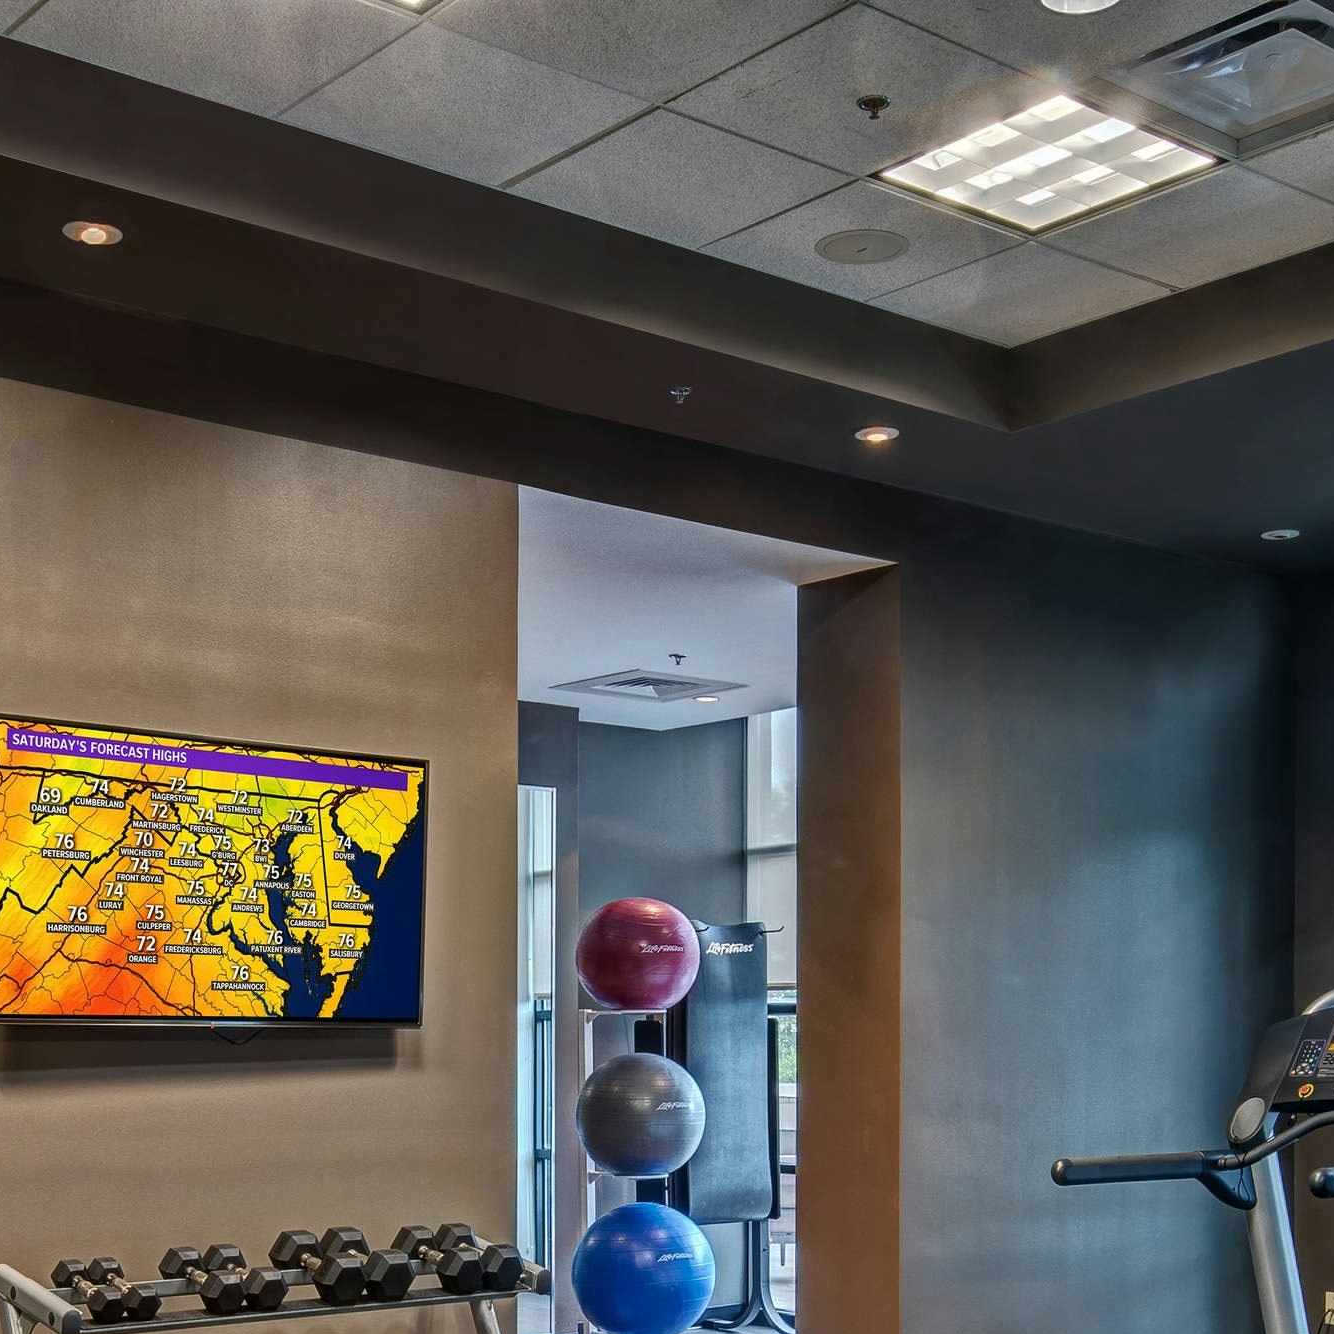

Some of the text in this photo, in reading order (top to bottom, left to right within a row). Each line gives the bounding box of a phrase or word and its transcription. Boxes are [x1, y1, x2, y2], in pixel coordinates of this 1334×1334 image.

[12, 733, 187, 763] SATURDAY'S FORECAST HIGHS
[91, 778, 109, 794] 74
[169, 777, 186, 792] 72
[40, 788, 61, 803] 69
[75, 797, 124, 808] CUMBERLAND
[151, 792, 198, 803] HAGERSTOWN
[230, 790, 248, 805] 72
[31, 803, 68, 814] OAKLAND
[151, 803, 168, 819] 72
[197, 808, 214, 823] 74
[217, 804, 262, 815] WESTMINSTER
[287, 809, 303, 824] 72
[132, 820, 181, 831] MARTINSBURG
[189, 824, 225, 834] FREDERICK
[281, 824, 313, 833] ABERDEEN
[54, 834, 74, 849] 76
[134, 832, 153, 846] 70
[215, 835, 232, 850] 75
[253, 838, 270, 853] 73
[336, 835, 353, 850] 74
[42, 849, 90, 860] PETERSBURG
[120, 848, 164, 858] WINCHESTER
[178, 842, 196, 857] 74
[212, 851, 236, 860] G'BURG
[335, 852, 355, 861] DOVER
[131, 858, 149, 873] 74
[170, 858, 203, 868] LEESBURG
[255, 854, 267, 863] BWI
[221, 862, 239, 876] 77
[263, 865, 280, 880] 75
[117, 873, 163, 883] FRONT ROYAL
[224, 878, 234, 887] DC
[295, 873, 312, 888] 75
[104, 882, 124, 898] 74
[186, 881, 205, 896] 75
[255, 881, 290, 890] ANNAPOLIS
[344, 884, 362, 899] 75
[177, 896, 213, 906] MANASSAS
[240, 887, 258, 902] 74
[292, 890, 315, 899] EASTON
[98, 901, 122, 910] LURAY
[145, 905, 164, 920] 75
[232, 904, 263, 913] ANDREWS
[300, 902, 317, 917] 74
[333, 901, 374, 911] GEORGETOWN
[67, 906, 87, 922] 76
[47, 923, 105, 934] HARRISONBURG
[137, 922, 171, 931] CULPEPER
[290, 919, 325, 929] CAMBRIDGE
[183, 929, 202, 944] 74
[266, 930, 284, 945] 76
[338, 933, 355, 948] 76
[137, 936, 156, 952] 72
[165, 945, 222, 956] FREDERICKSBURG
[250, 945, 302, 954] PATUXENT RIVER
[128, 954, 157, 963] ORANGE
[330, 950, 364, 959] SALISBURY
[230, 966, 250, 981] 76
[212, 982, 264, 991] TAPPAHANNOCK
